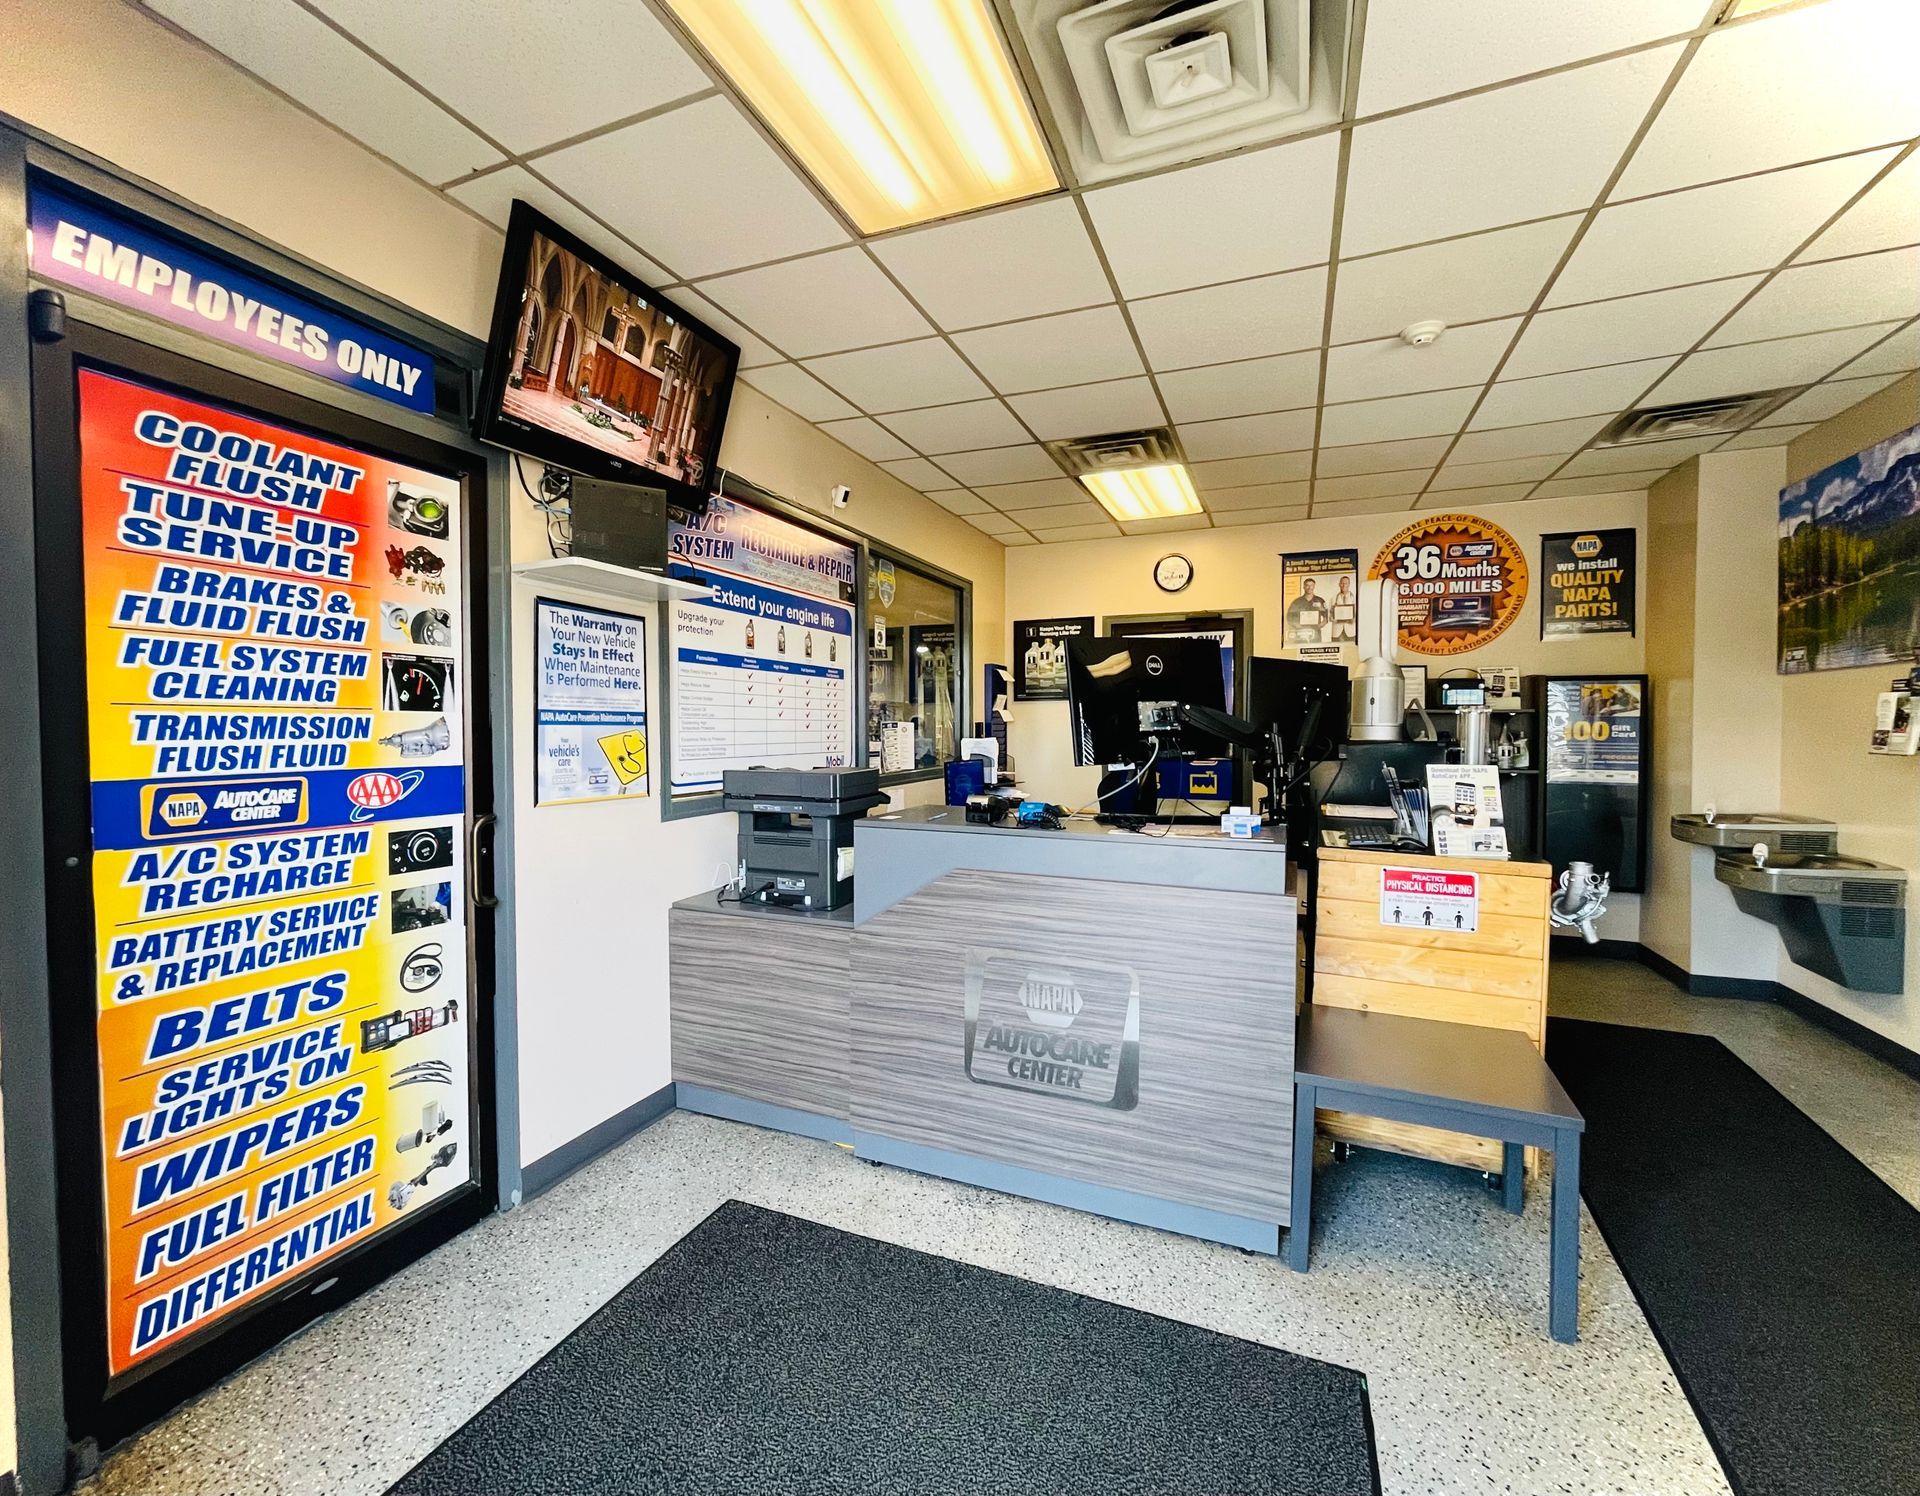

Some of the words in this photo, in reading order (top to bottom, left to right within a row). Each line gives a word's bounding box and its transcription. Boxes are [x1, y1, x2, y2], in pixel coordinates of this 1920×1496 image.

[53, 220, 331, 363] EMPLOYEES
[336, 344, 422, 396] ONLY
[135, 411, 364, 494] COOLANT
[171, 452, 323, 514] FLUSH
[119, 482, 360, 551] TUNE-UP
[686, 512, 729, 535] A/C
[118, 515, 352, 580] SERVICE
[672, 533, 735, 560] SYSTEM
[740, 525, 806, 568] RECHARGE
[807, 554, 816, 571] &
[818, 556, 853, 583] REPAIR
[1385, 521, 1422, 551] AUTOCARE
[1494, 529, 1522, 564] WARRANTY
[1576, 541, 1598, 552] NAPA
[1395, 544, 1441, 580] 36
[1440, 560, 1500, 579] Months
[1556, 562, 1575, 571] we
[1578, 558, 1617, 570] install
[157, 565, 324, 611] BRAKES
[326, 593, 353, 617] &
[1398, 581, 1446, 597] 6,000
[1449, 579, 1503, 594] MILES
[1550, 570, 1624, 588] QUALITY
[1563, 587, 1611, 602] NAPA
[117, 595, 247, 637] FLUID
[256, 608, 366, 645] FLUSH
[677, 609, 708, 625] Upgrade
[709, 616, 725, 627] your
[712, 584, 756, 611] Extend
[758, 600, 784, 617] your
[786, 606, 819, 626] engine
[821, 611, 835, 628] life
[1555, 602, 1617, 618] PARTS!
[549, 610, 570, 626] The
[572, 614, 623, 635] Warranty
[625, 625, 637, 636] on
[550, 627, 576, 642] Your
[578, 629, 601, 645] New
[603, 634, 636, 650] Vehicle
[677, 623, 714, 637] protection
[1400, 639, 1445, 654] ONVENIENT
[1447, 636, 1491, 654] LOCATIONS
[1494, 595, 1523, 635] NATIONALLY
[122, 636, 223, 671] FUEL
[231, 643, 367, 679] SYSTEM
[544, 657, 577, 672] When
[580, 661, 641, 677] Maintenance
[552, 643, 586, 660] Stays
[588, 647, 599, 660] In
[602, 649, 634, 663] Effect
[152, 670, 336, 705] CLEANING
[546, 673, 555, 685] Is
[557, 673, 611, 689] Performed
[614, 677, 641, 690] Here.
[131, 714, 372, 744] TRANSMISSION
[156, 745, 261, 774] FLUSH
[269, 743, 348, 769] FLUID
[548, 744, 580, 757] vehicle's
[558, 758, 572, 767] care
[826, 756, 845, 767] Mobil
[349, 774, 401, 807] AAA
[168, 801, 200, 818] NAPA
[230, 804, 282, 822] CENTER
[126, 843, 217, 883] A/C
[224, 830, 370, 868] SYSTEM
[143, 859, 352, 914] RECHARGE
[1386, 879, 1424, 892] PHYSICAL
[1425, 883, 1473, 895] DISTANCING
[1411, 874, 1447, 882] PRACTICE
[110, 909, 260, 972] BATTERY
[267, 893, 380, 938] SERVICE
[116, 973, 146, 1001] &
[155, 923, 367, 993] REPLACEMENT
[149, 971, 349, 1061] BELTS
[159, 1022, 342, 1104] SERVICE
[983, 1026, 1113, 1069] AUTOCARE
[1007, 1056, 1084, 1088] CENTER
[120, 1066, 287, 1154] LIGHTS
[298, 1046, 351, 1087] ON
[136, 1085, 364, 1211] WIPERS
[138, 1193, 247, 1283] FUEL
[255, 1136, 376, 1234] FILTER
[133, 1190, 376, 1352] DIFFERENTIAL
